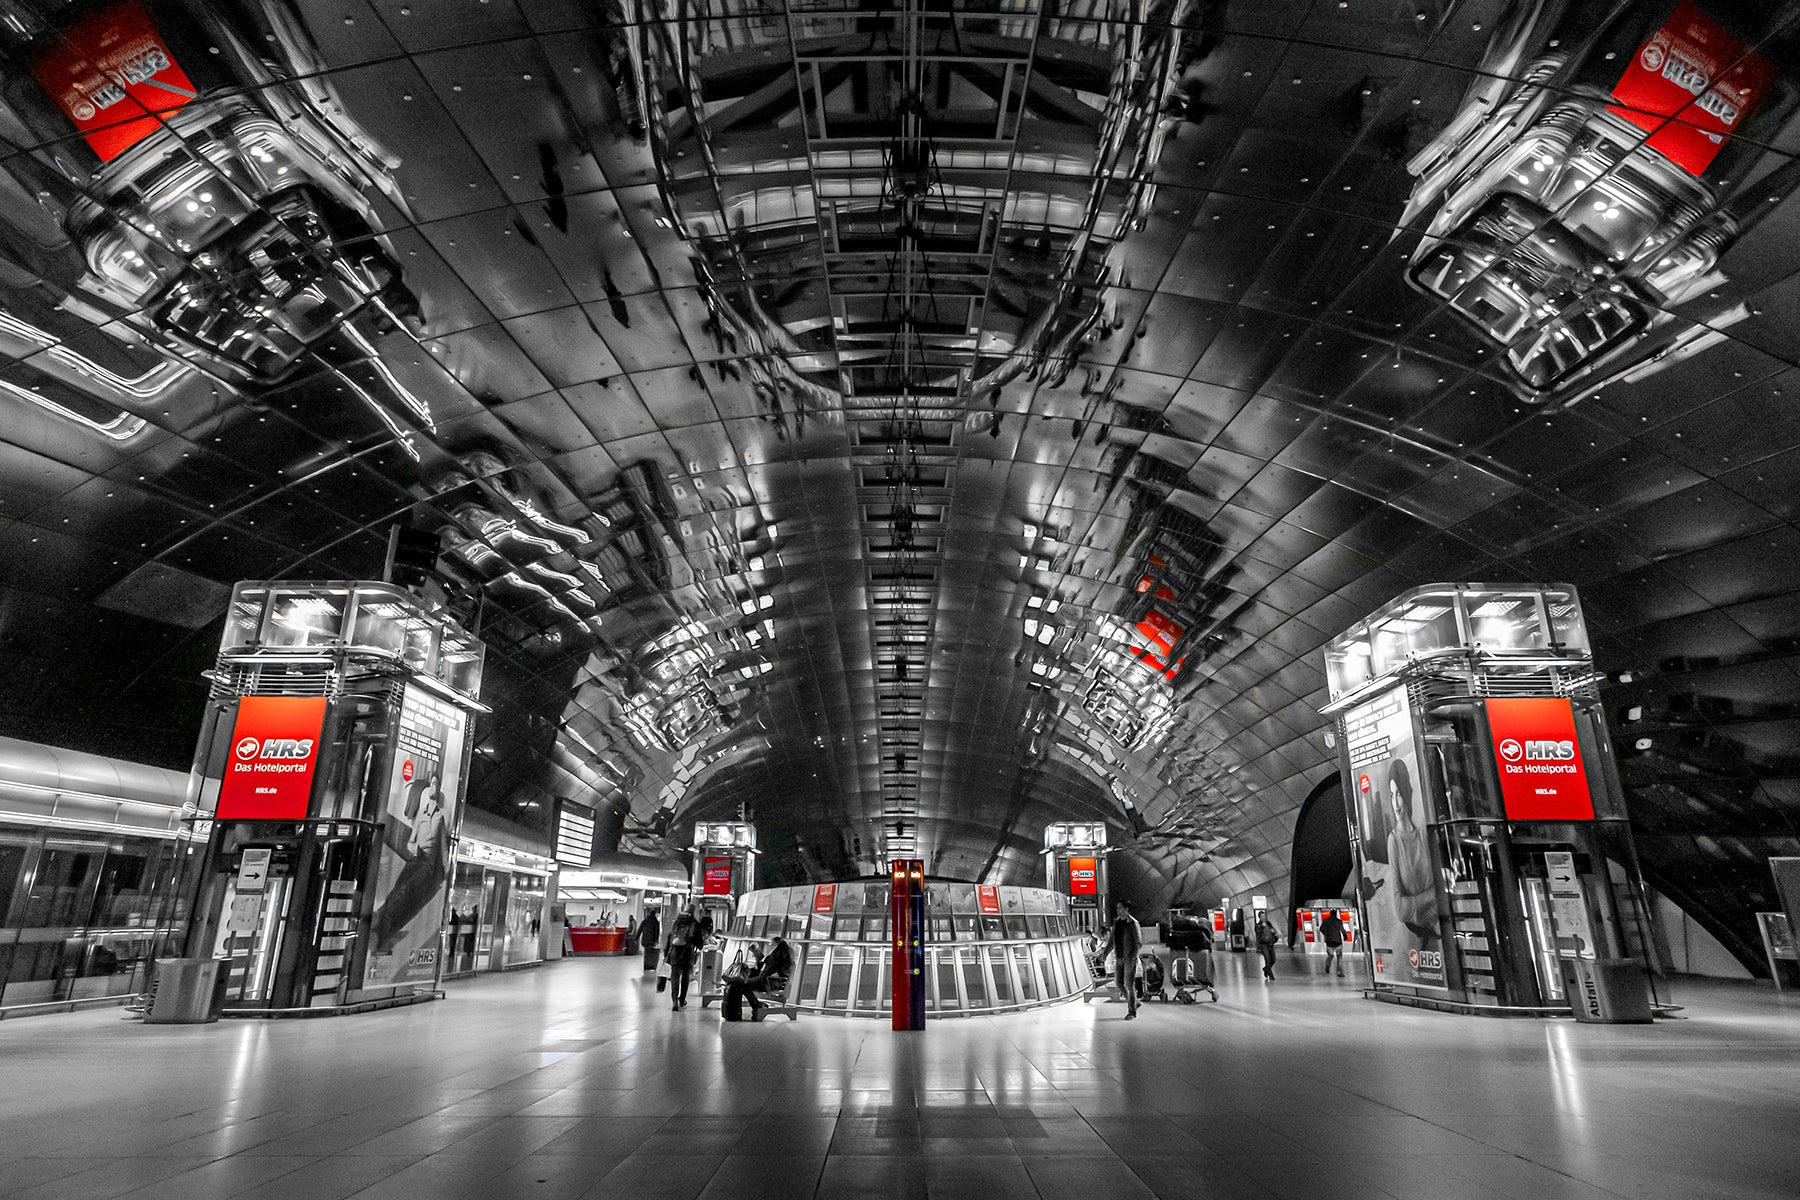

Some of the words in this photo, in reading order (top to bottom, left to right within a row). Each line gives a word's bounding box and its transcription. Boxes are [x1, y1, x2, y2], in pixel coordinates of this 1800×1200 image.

[260, 739, 314, 759] HRS
[1525, 740, 1574, 760] HRS
[234, 763, 252, 772] Das
[254, 763, 307, 773] Hotelportal
[1505, 764, 1523, 773] Das
[1524, 764, 1577, 775] Hotelportal
[416, 948, 436, 965] HRS
[1419, 950, 1442, 969] HRS
[146, 980, 160, 1016] Abfall
[1584, 981, 1601, 1017] Abfall
